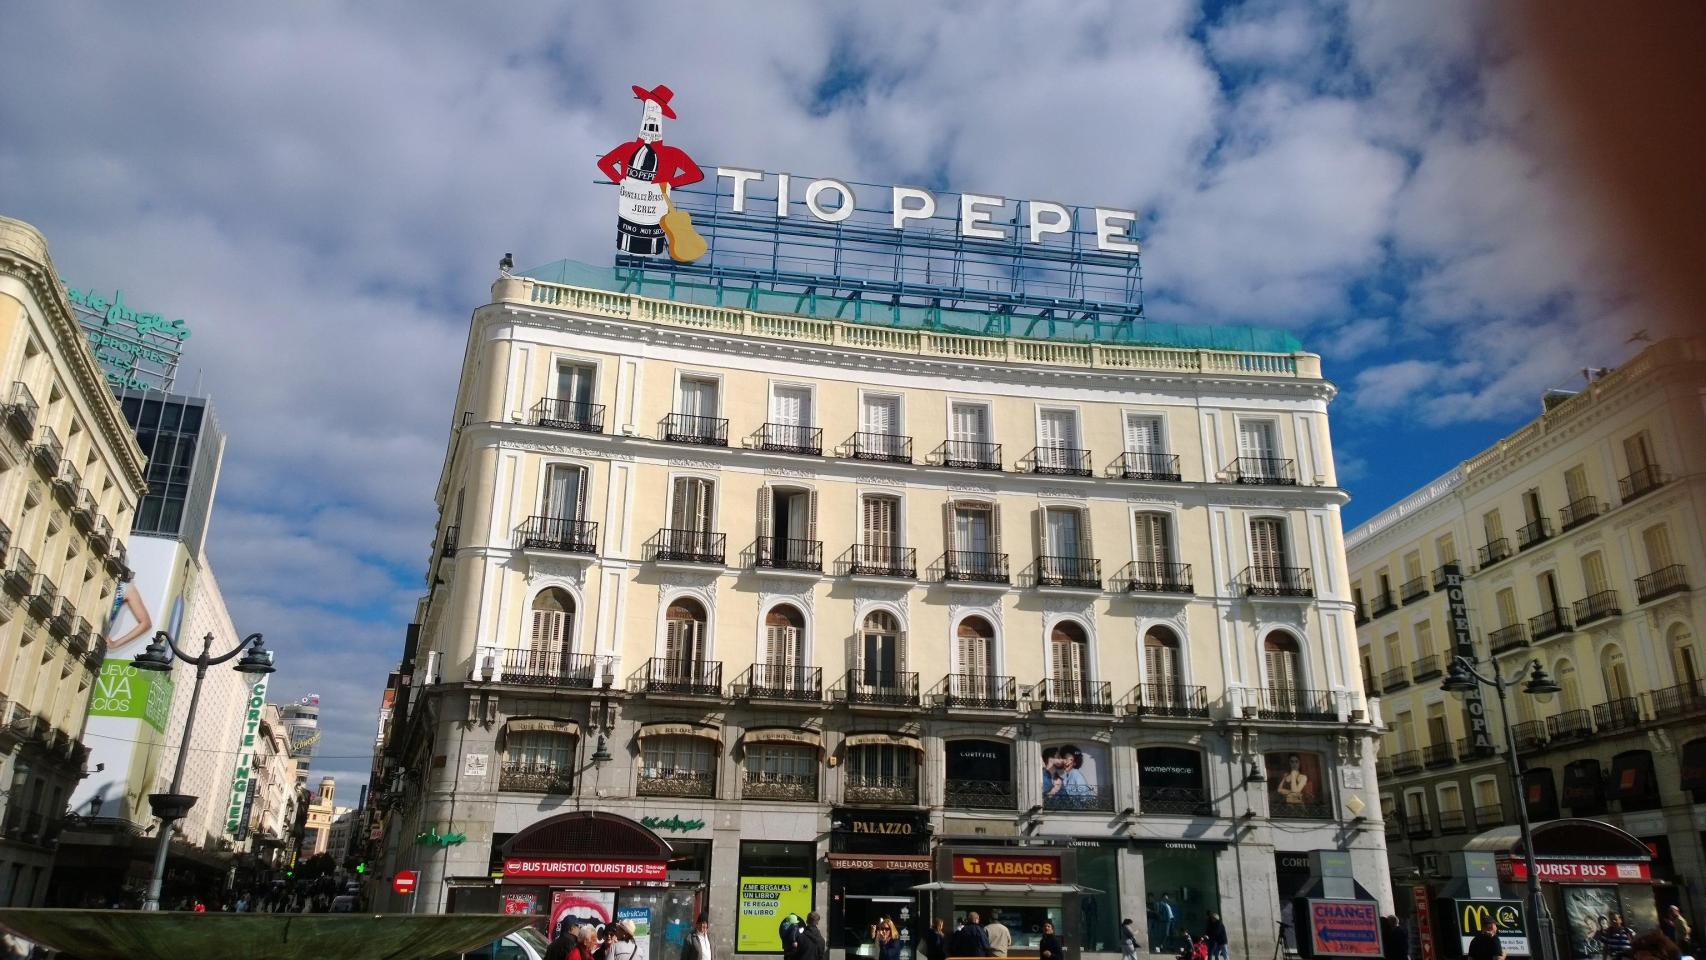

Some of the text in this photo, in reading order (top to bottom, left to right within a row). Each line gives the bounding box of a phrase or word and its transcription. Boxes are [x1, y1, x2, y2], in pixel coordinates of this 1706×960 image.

[632, 204, 656, 214] JEREZ
[717, 166, 1141, 253] TIO PEPE
[90, 332, 166, 363] DEPORTES
[1448, 574, 1471, 645] HOTEL
[99, 664, 138, 677] UEVO
[243, 684, 265, 746] CORTE
[853, 821, 912, 834] PALAZZO
[522, 862, 540, 871] BUS
[541, 861, 587, 872] TURÍSTICO
[589, 862, 625, 873] TOURIST
[626, 864, 643, 873] BUS
[836, 860, 929, 870] HELADOS ITALIANOS
[986, 861, 1052, 875] TABACOS
[1581, 864, 1607, 876] BUS
[1314, 905, 1374, 919] CHANGE
[1503, 911, 1515, 920] 24
